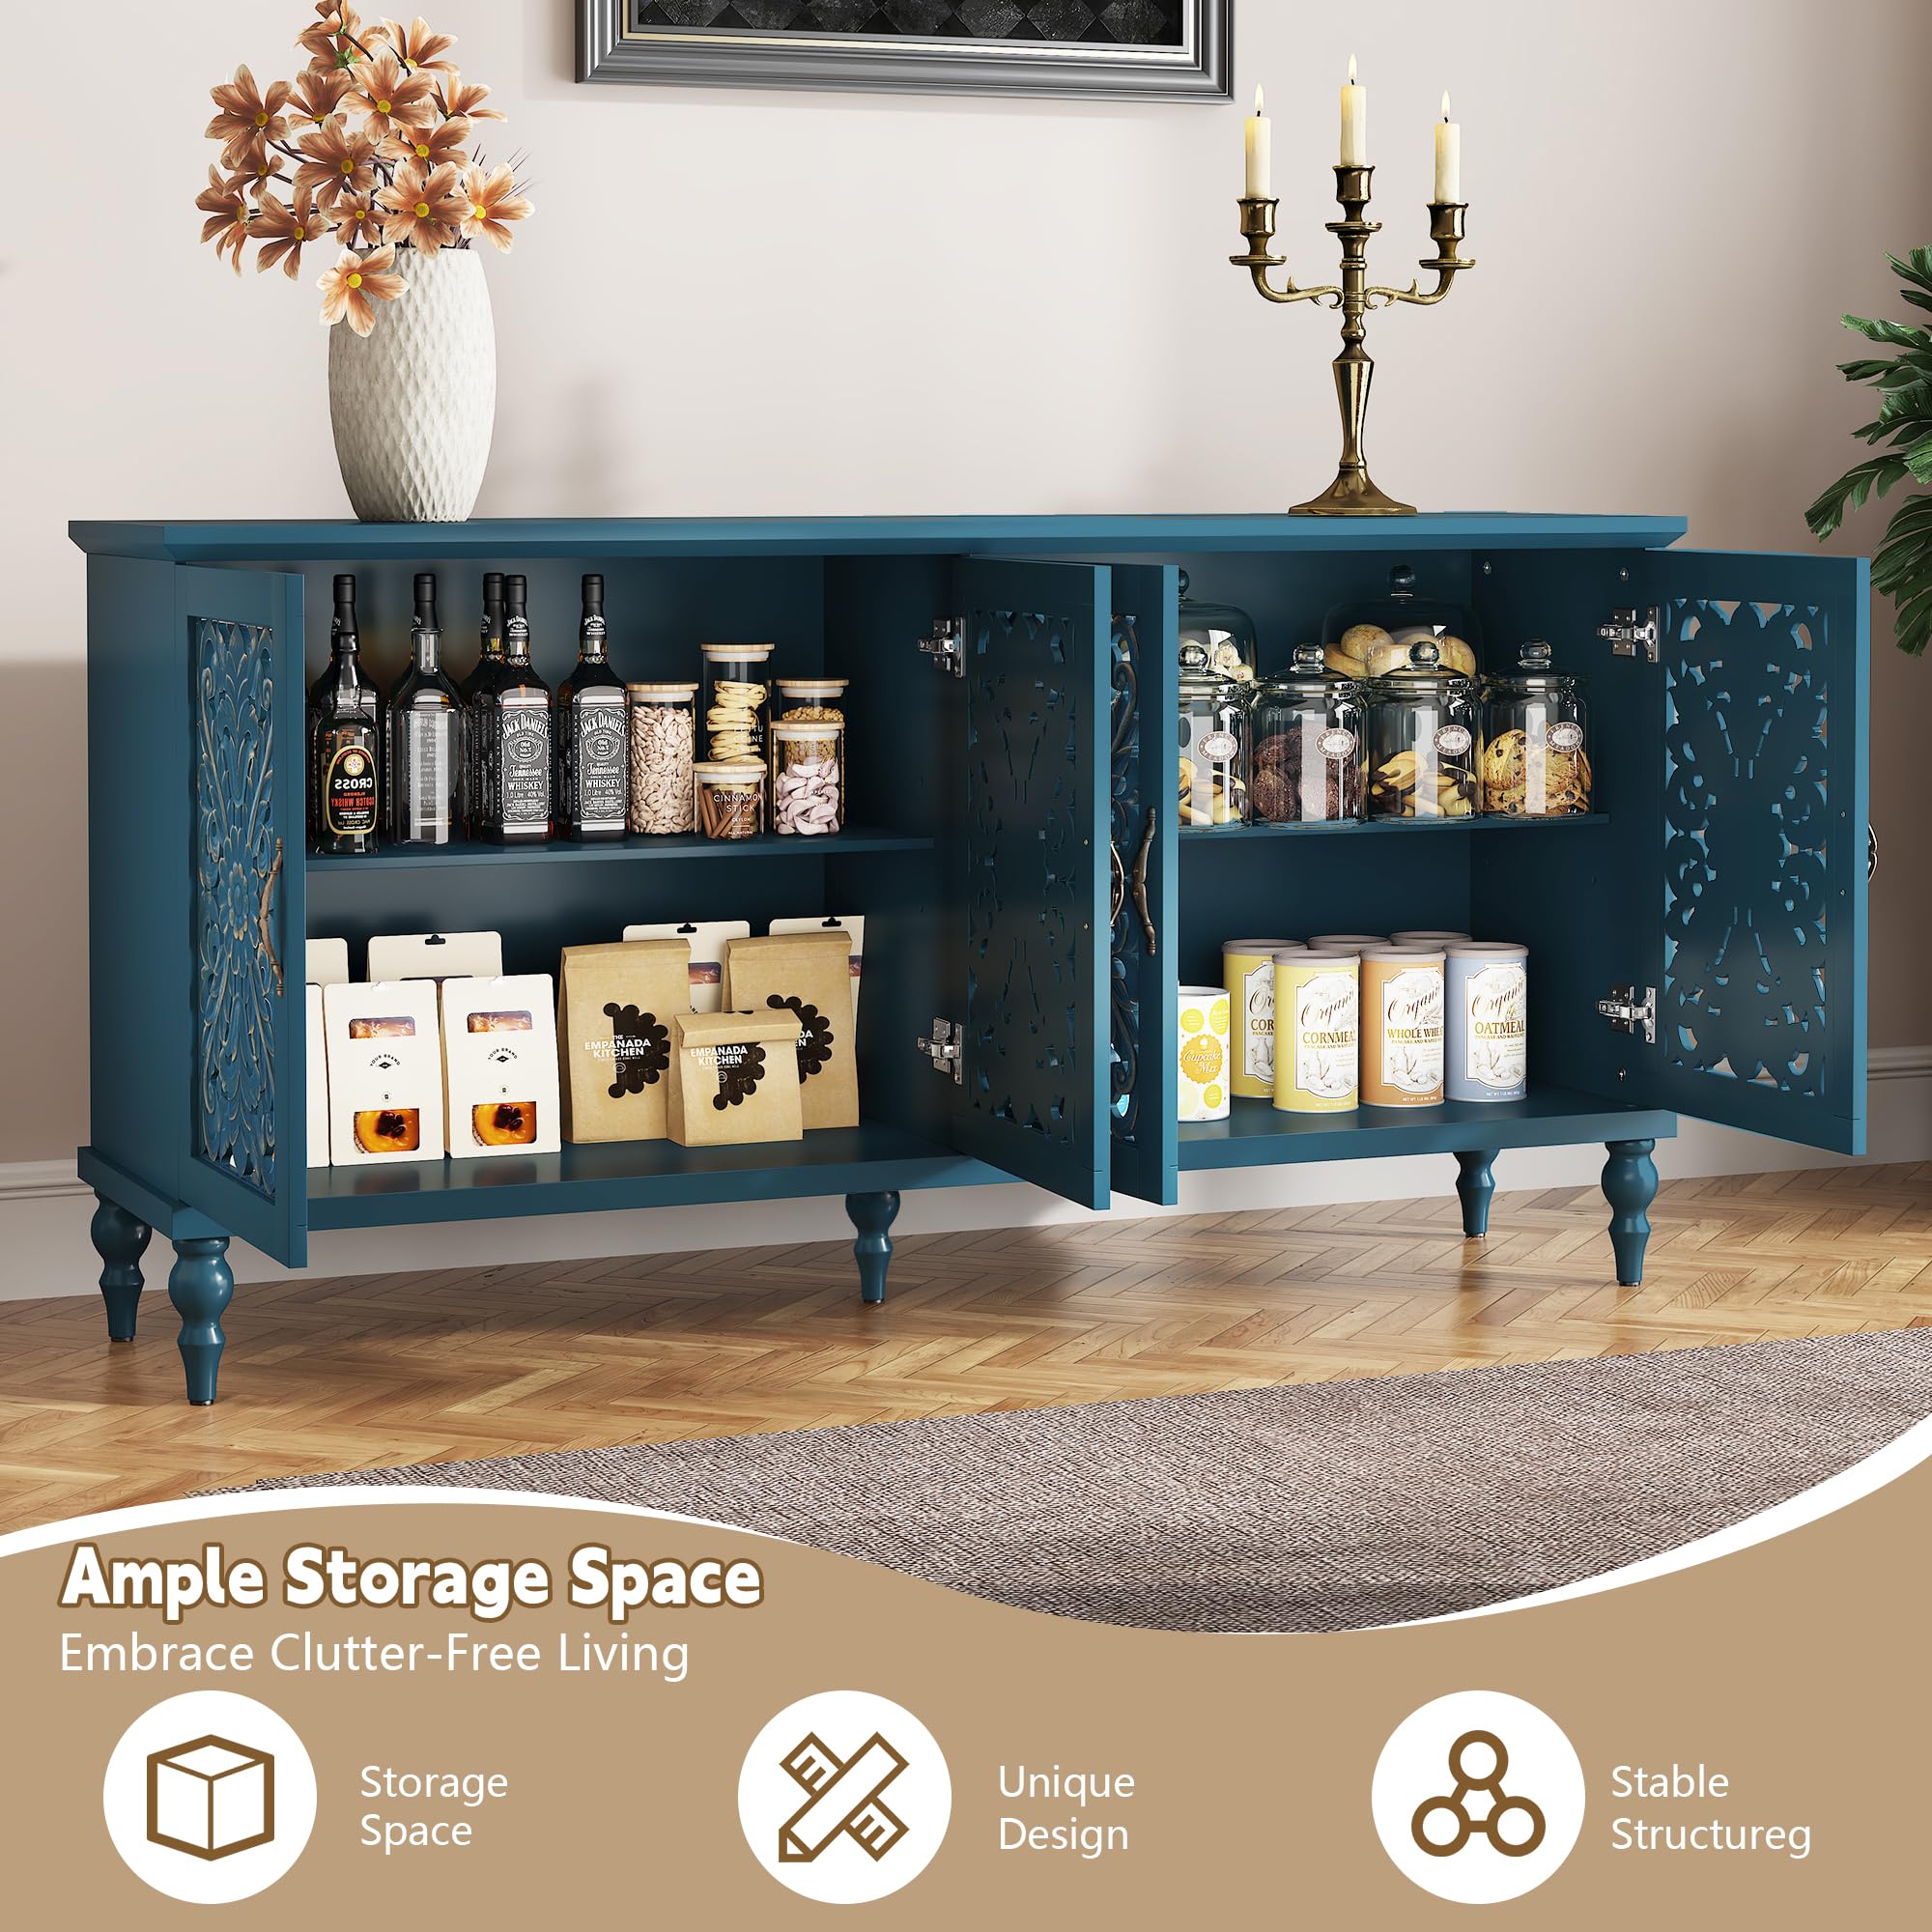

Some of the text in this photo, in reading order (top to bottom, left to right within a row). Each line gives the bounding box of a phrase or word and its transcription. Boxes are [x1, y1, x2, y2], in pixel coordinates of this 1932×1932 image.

[502, 719, 521, 740] JACK
[580, 718, 599, 738] JACK
[509, 765, 543, 778] Tennessee
[586, 762, 620, 776] Tennessee
[507, 781, 544, 791] WHISKEY
[585, 779, 621, 788] WHISKEY
[713, 793, 762, 803] CINNAMON
[726, 804, 755, 812] STICK
[1387, 1028, 1422, 1038] WHOLE
[1475, 1020, 1524, 1034] OATMEAL
[584, 1038, 651, 1051] EMPANADA
[501, 1047, 518, 1060] BRAND
[592, 1048, 645, 1059] KITCHEN
[690, 1045, 749, 1058] EMPANADA
[1182, 1050, 1221, 1065] Cupcake
[384, 1054, 401, 1065] BRAND
[697, 1055, 743, 1065] KITCHEN
